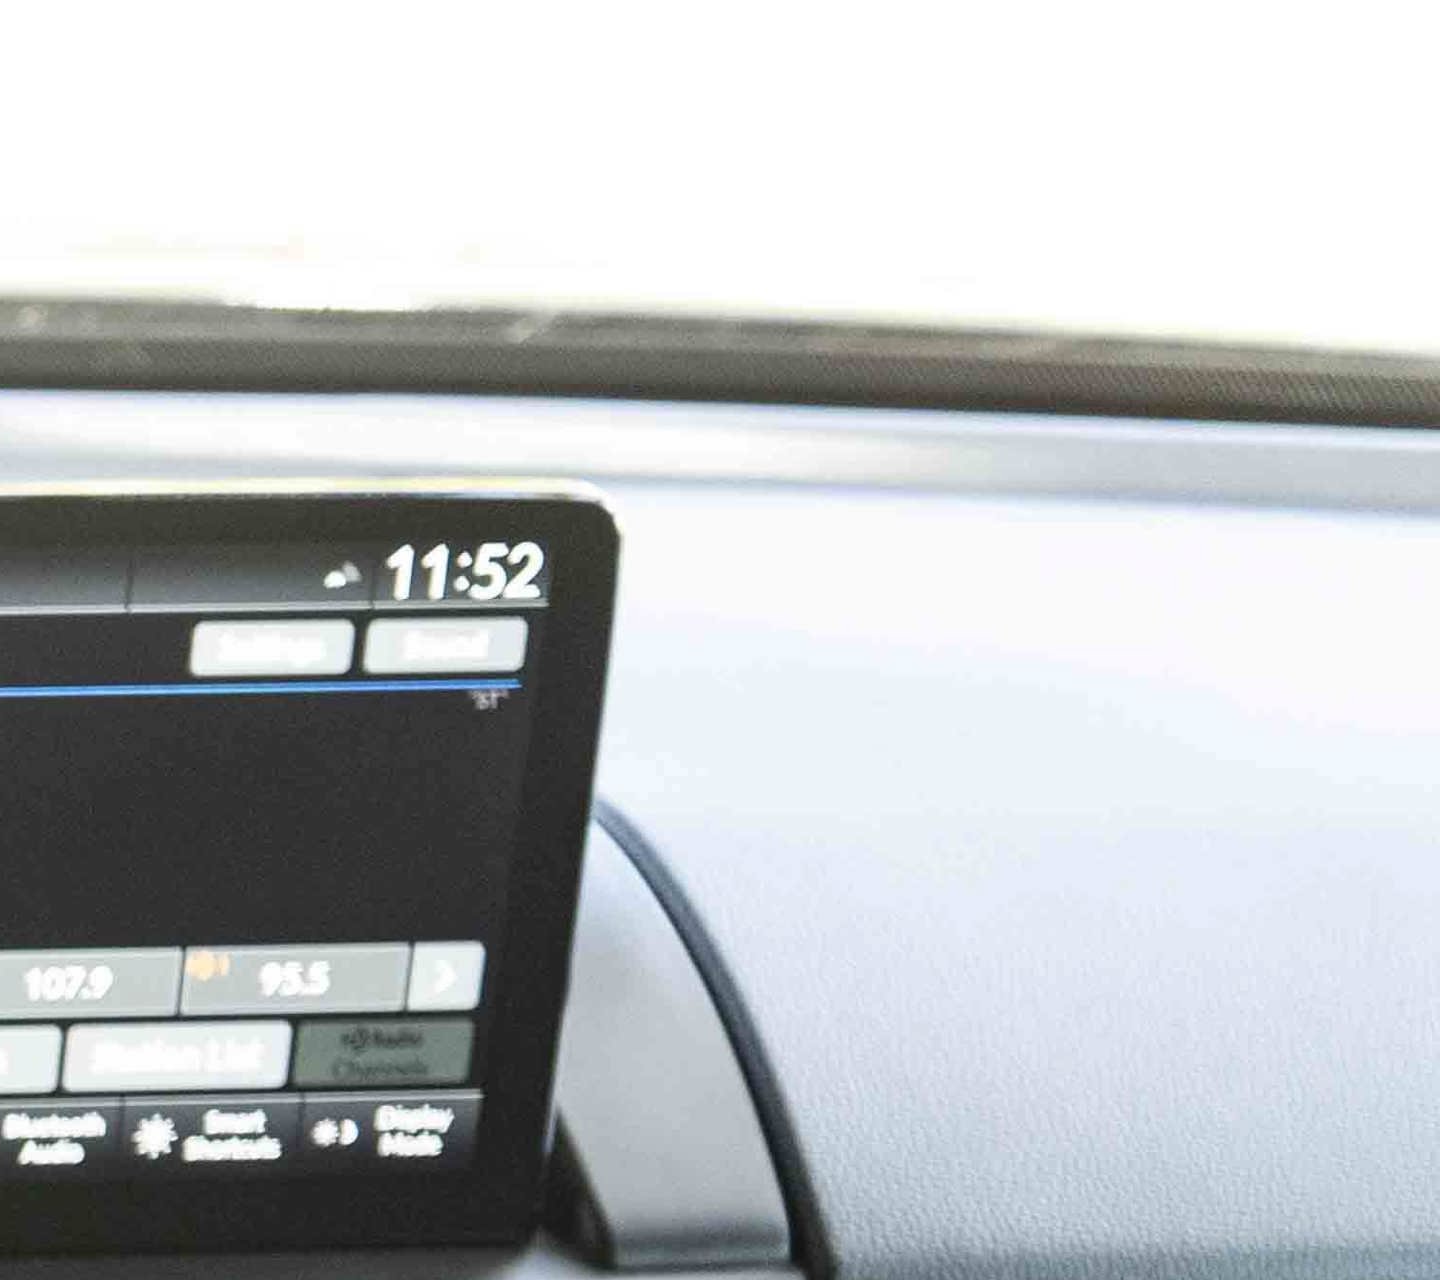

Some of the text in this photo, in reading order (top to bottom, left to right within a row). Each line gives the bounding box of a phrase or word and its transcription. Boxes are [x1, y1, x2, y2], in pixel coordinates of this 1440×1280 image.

[386, 542, 543, 600] 11:52
[25, 965, 114, 1000] 107.9
[259, 961, 332, 996] 95.5
